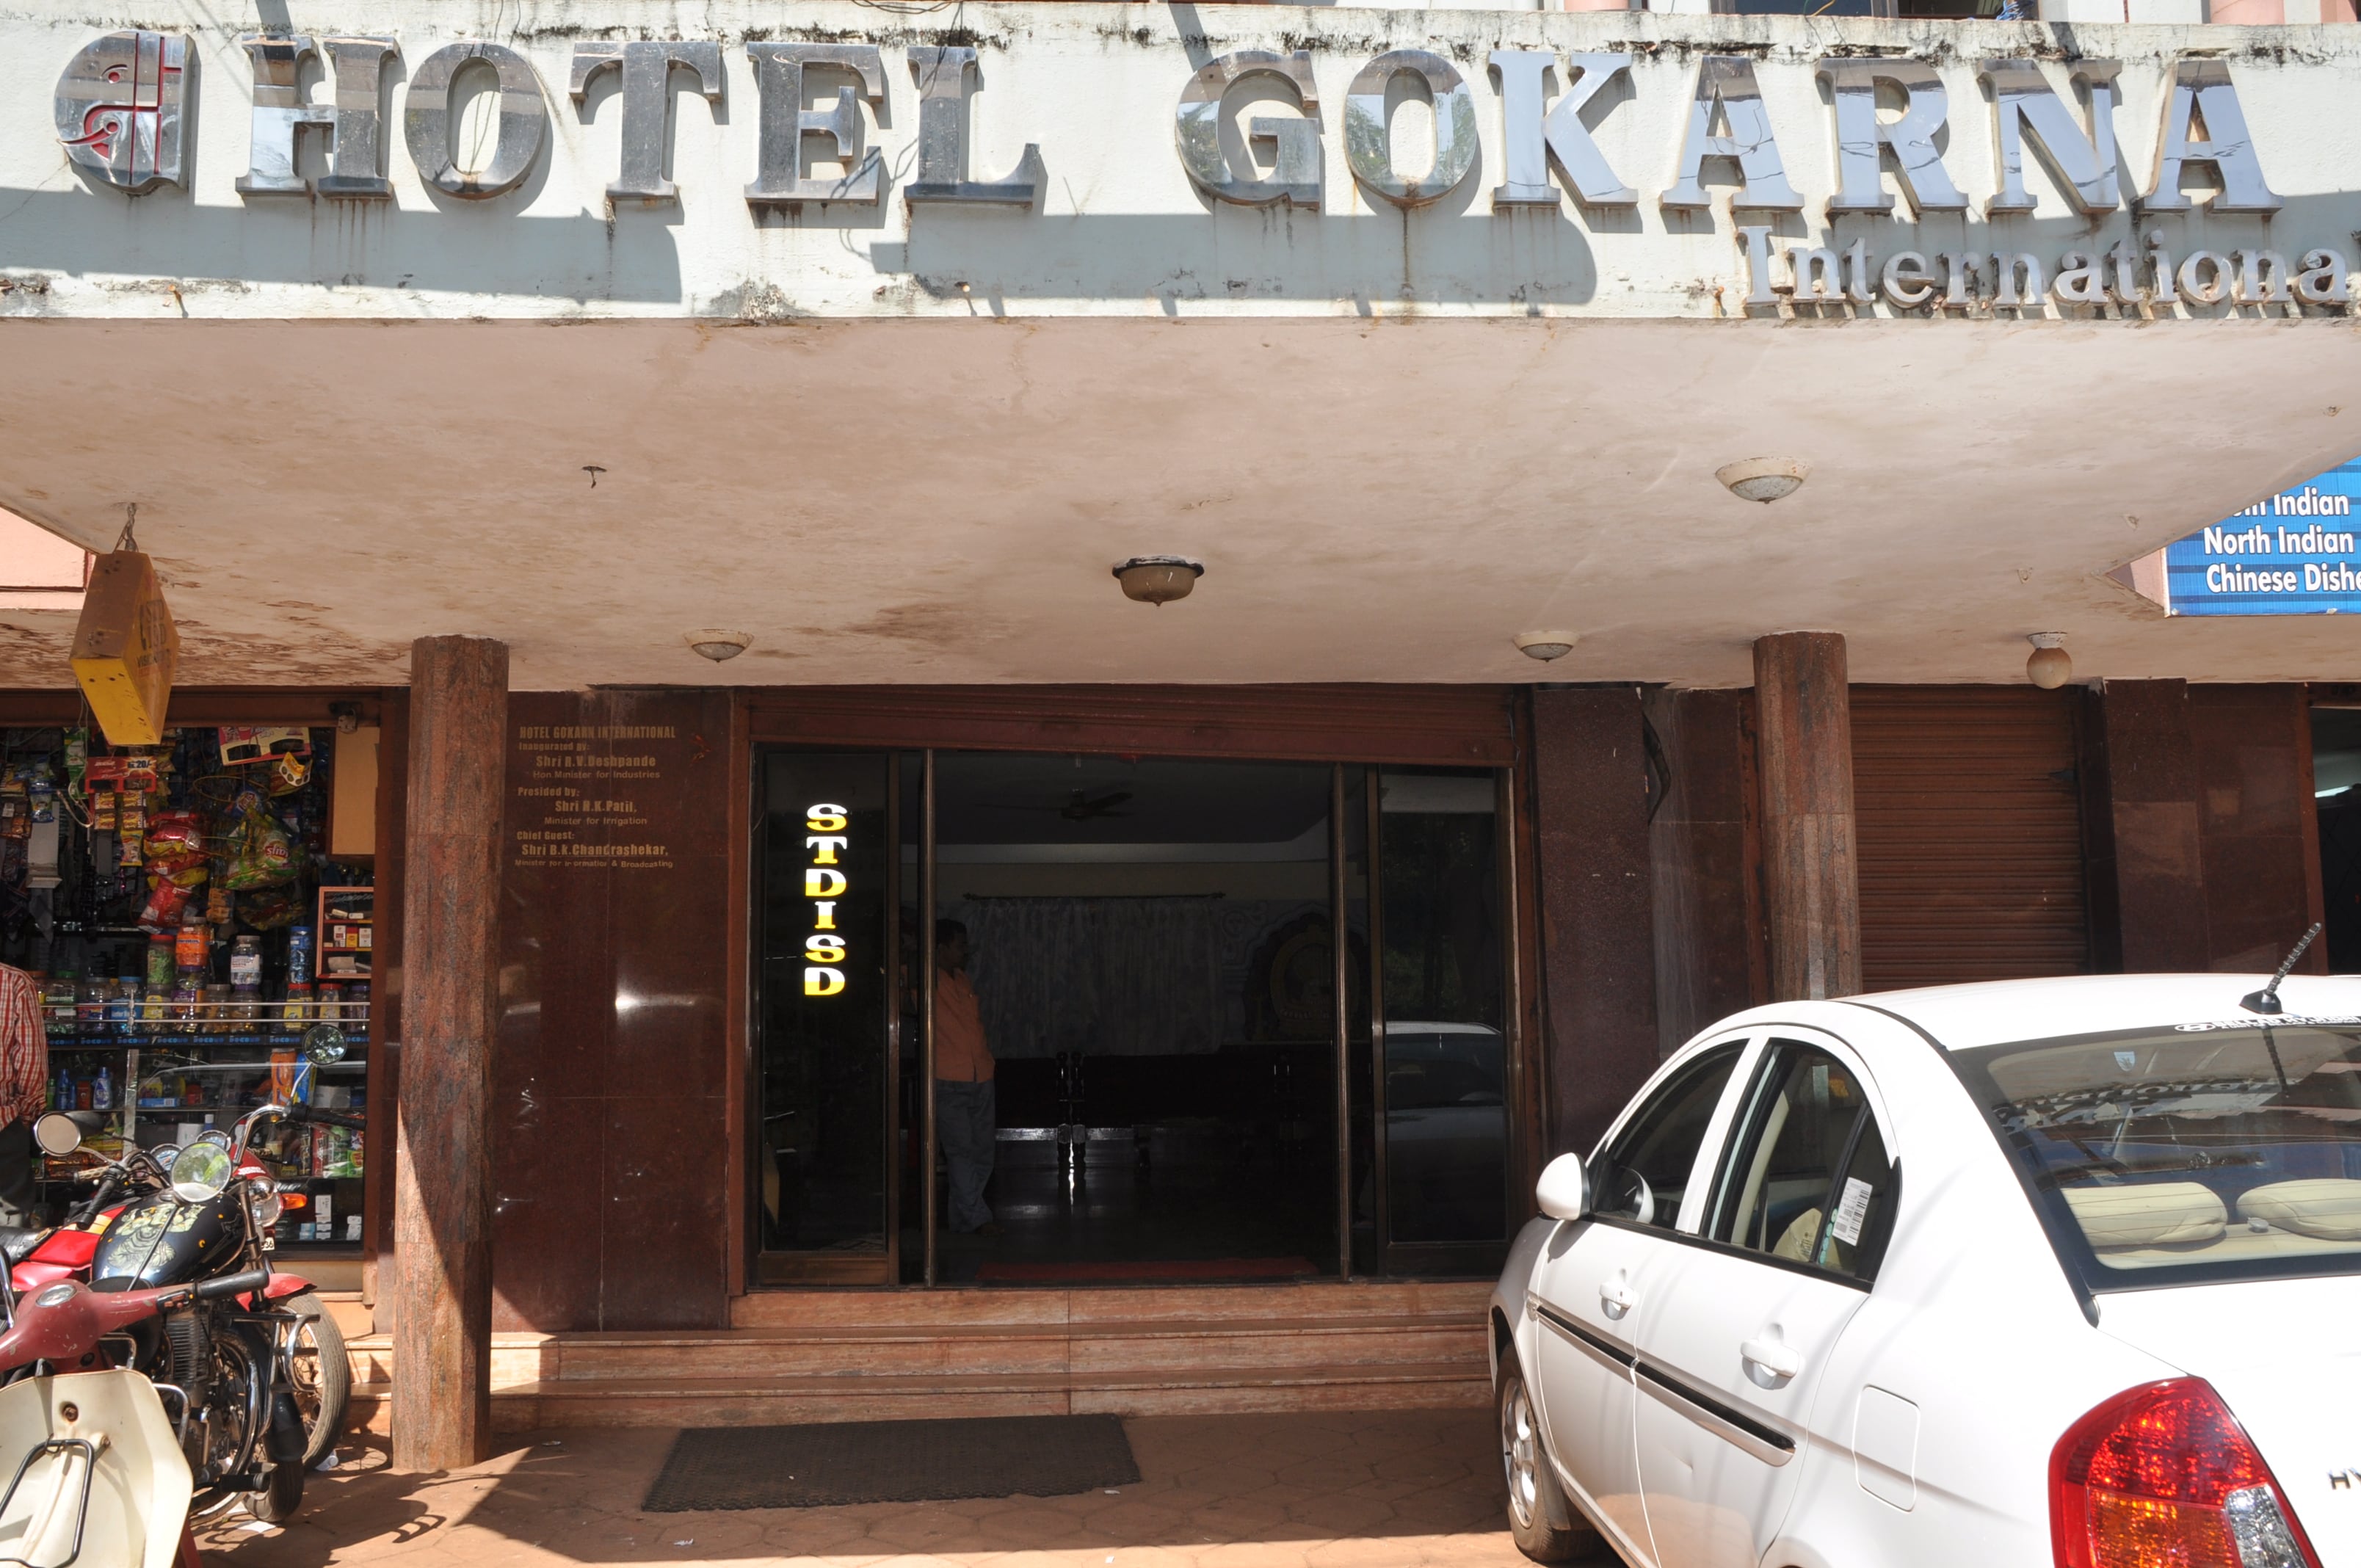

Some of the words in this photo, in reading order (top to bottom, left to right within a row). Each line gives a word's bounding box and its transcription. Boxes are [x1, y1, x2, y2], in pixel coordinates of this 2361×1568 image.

[235, 35, 1040, 203] HOTEL
[1176, 49, 2285, 213] GOKARNA
[1737, 225, 2361, 308] Internationa
[2274, 487, 2349, 515] Indian
[2203, 524, 2271, 554] North
[2277, 524, 2354, 553] Indian
[2205, 562, 2297, 592] Chinese
[519, 726, 551, 738] HOTEL
[554, 726, 595, 738] GOKARN
[598, 725, 676, 738] INTERNATIONAL
[518, 741, 573, 751] Inaugurated
[536, 755, 562, 767] Shri
[596, 770, 609, 779] for
[612, 771, 661, 779] Industries
[518, 787, 562, 796] Presided
[564, 787, 580, 797] by:
[554, 800, 579, 812] Shri
[544, 817, 581, 825] Minister
[586, 817, 600, 825] for
[603, 816, 648, 827] Irrigation
[516, 830, 542, 840] Chief
[544, 830, 576, 841] Guest:
[521, 844, 547, 856] Shri
[620, 860, 673, 869] Broadcasting
